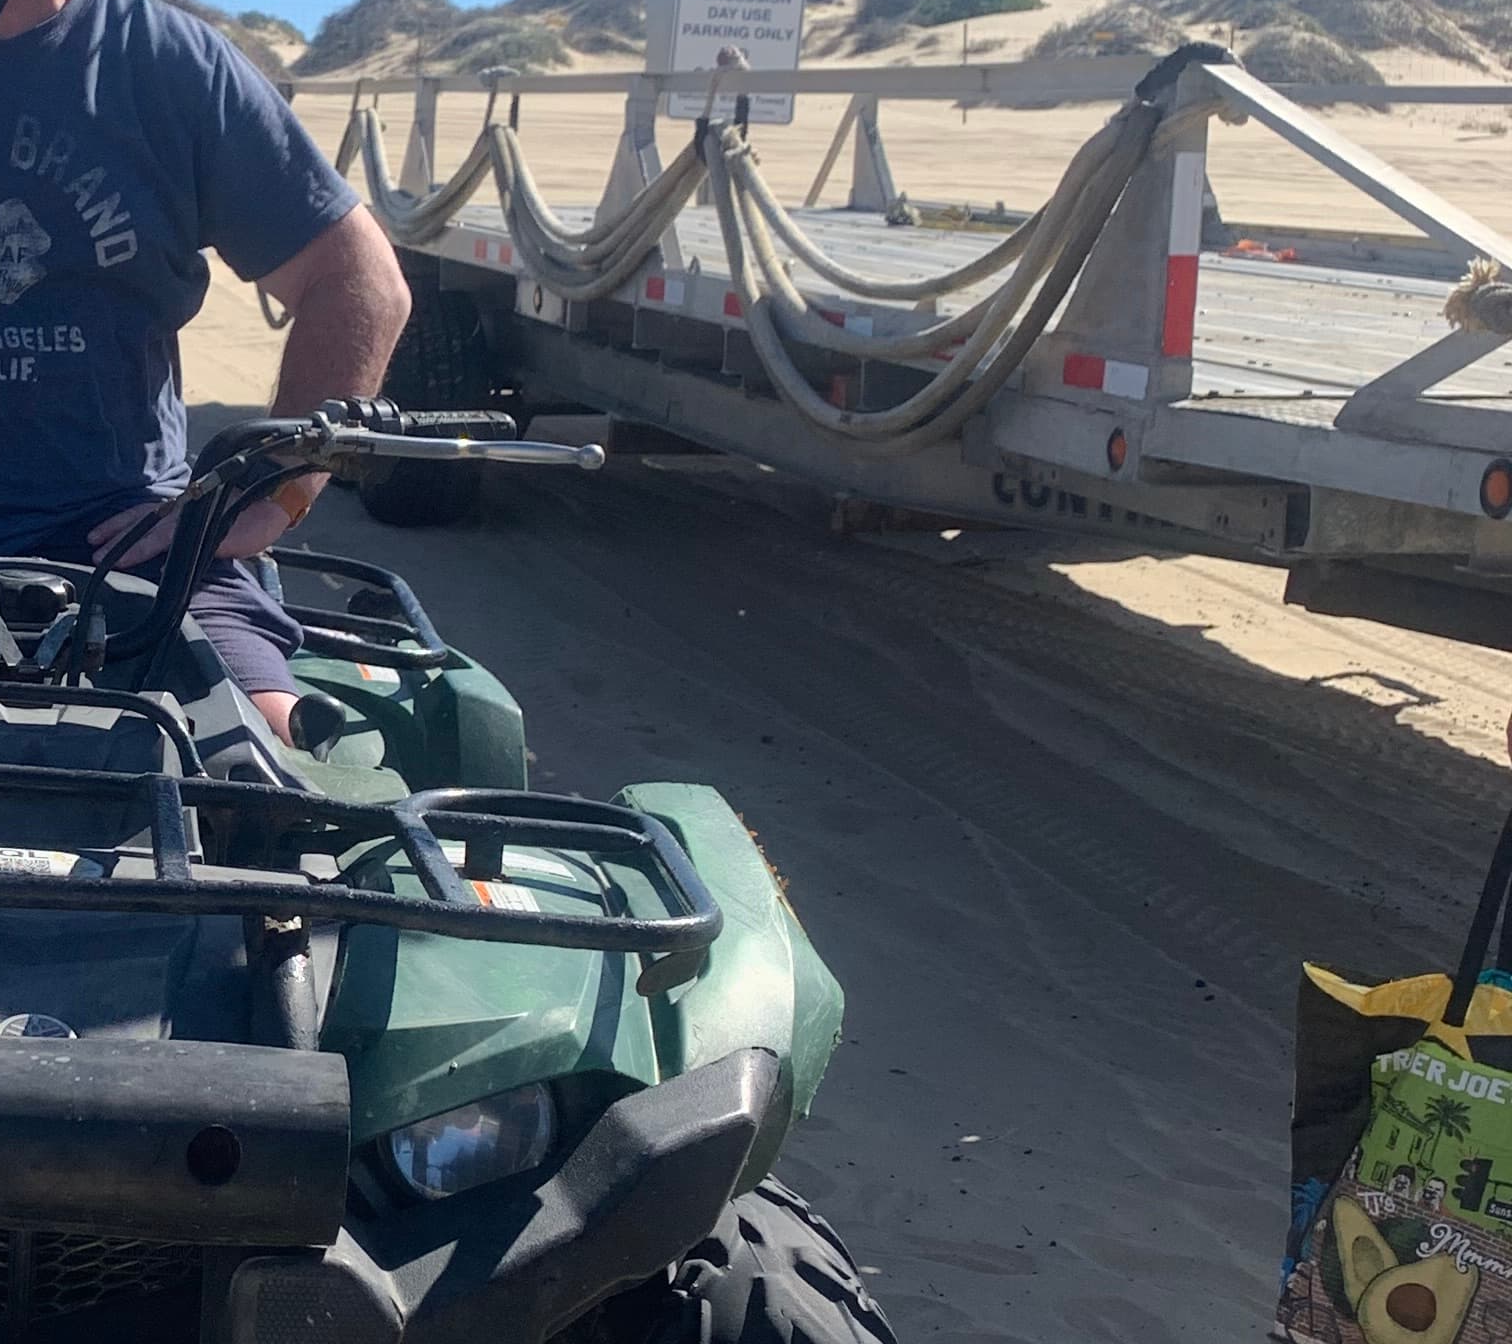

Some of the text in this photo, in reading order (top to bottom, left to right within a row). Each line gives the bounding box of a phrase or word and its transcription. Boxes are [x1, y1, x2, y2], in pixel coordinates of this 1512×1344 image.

[707, 6, 772, 22] DAY USE
[681, 23, 794, 41] PARKING ONLY
[10, 113, 138, 268] BRAND
